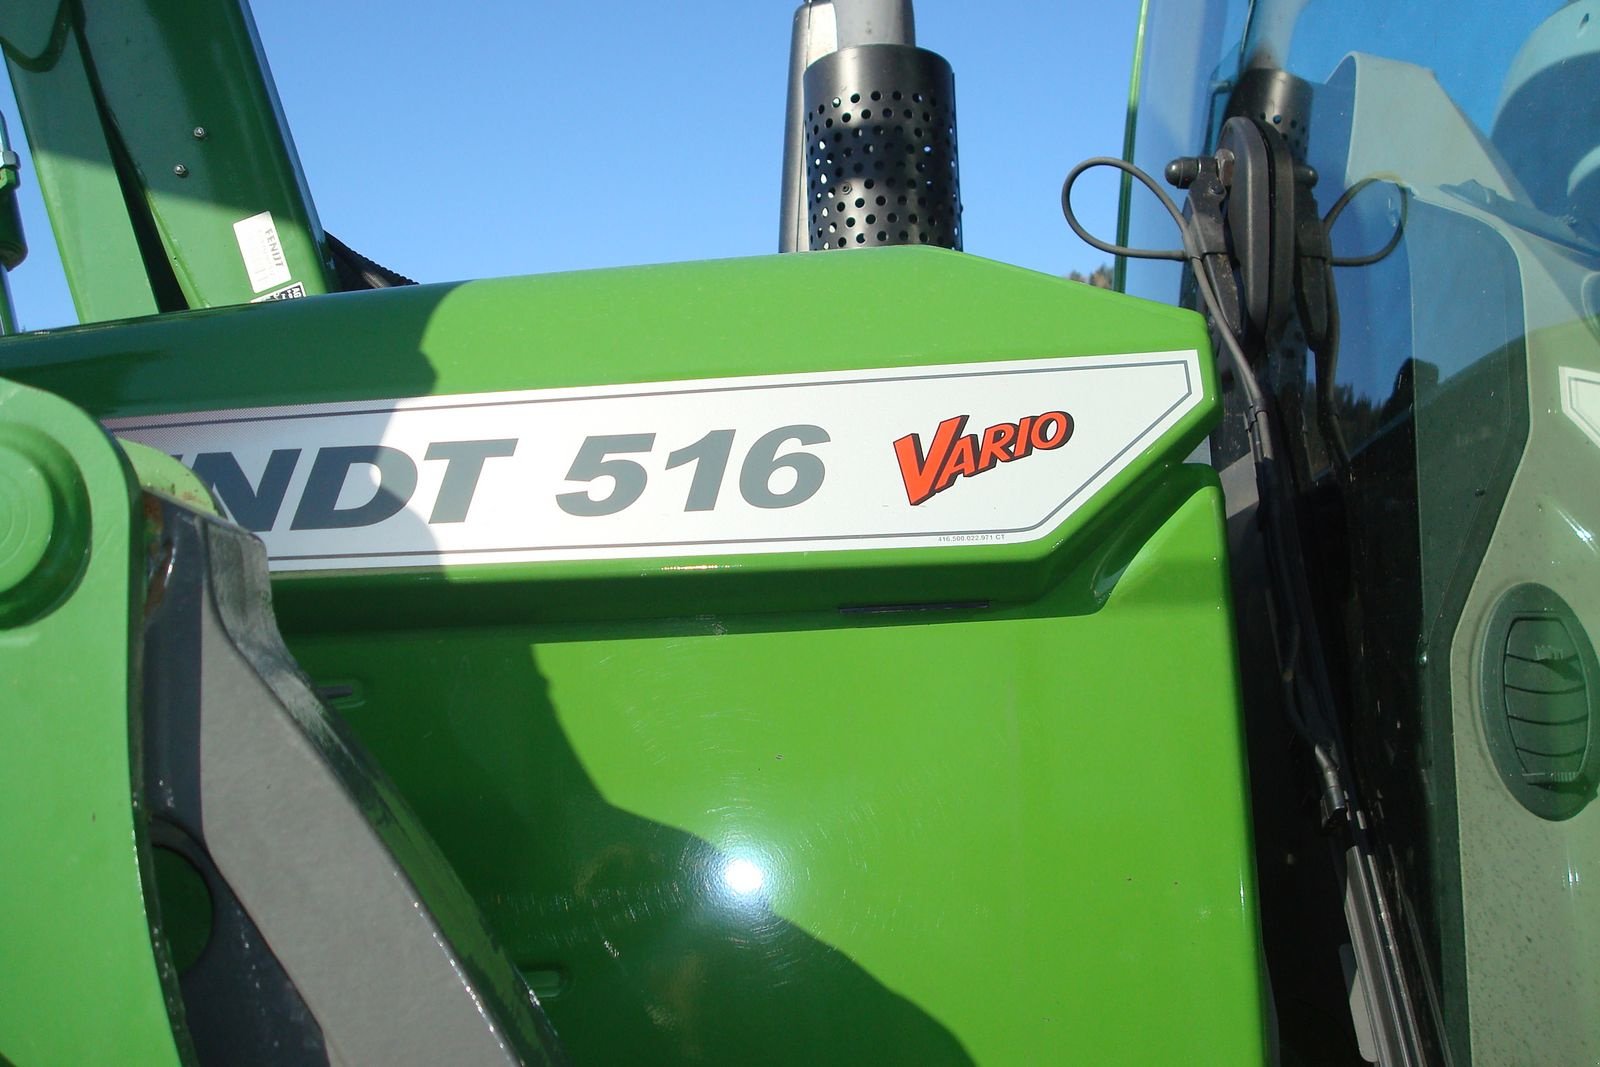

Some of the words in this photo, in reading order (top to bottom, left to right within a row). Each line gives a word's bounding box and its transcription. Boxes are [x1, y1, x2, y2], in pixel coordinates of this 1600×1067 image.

[171, 438, 518, 531] NDT
[555, 424, 831, 517] 516
[893, 411, 1075, 506] VARIO
